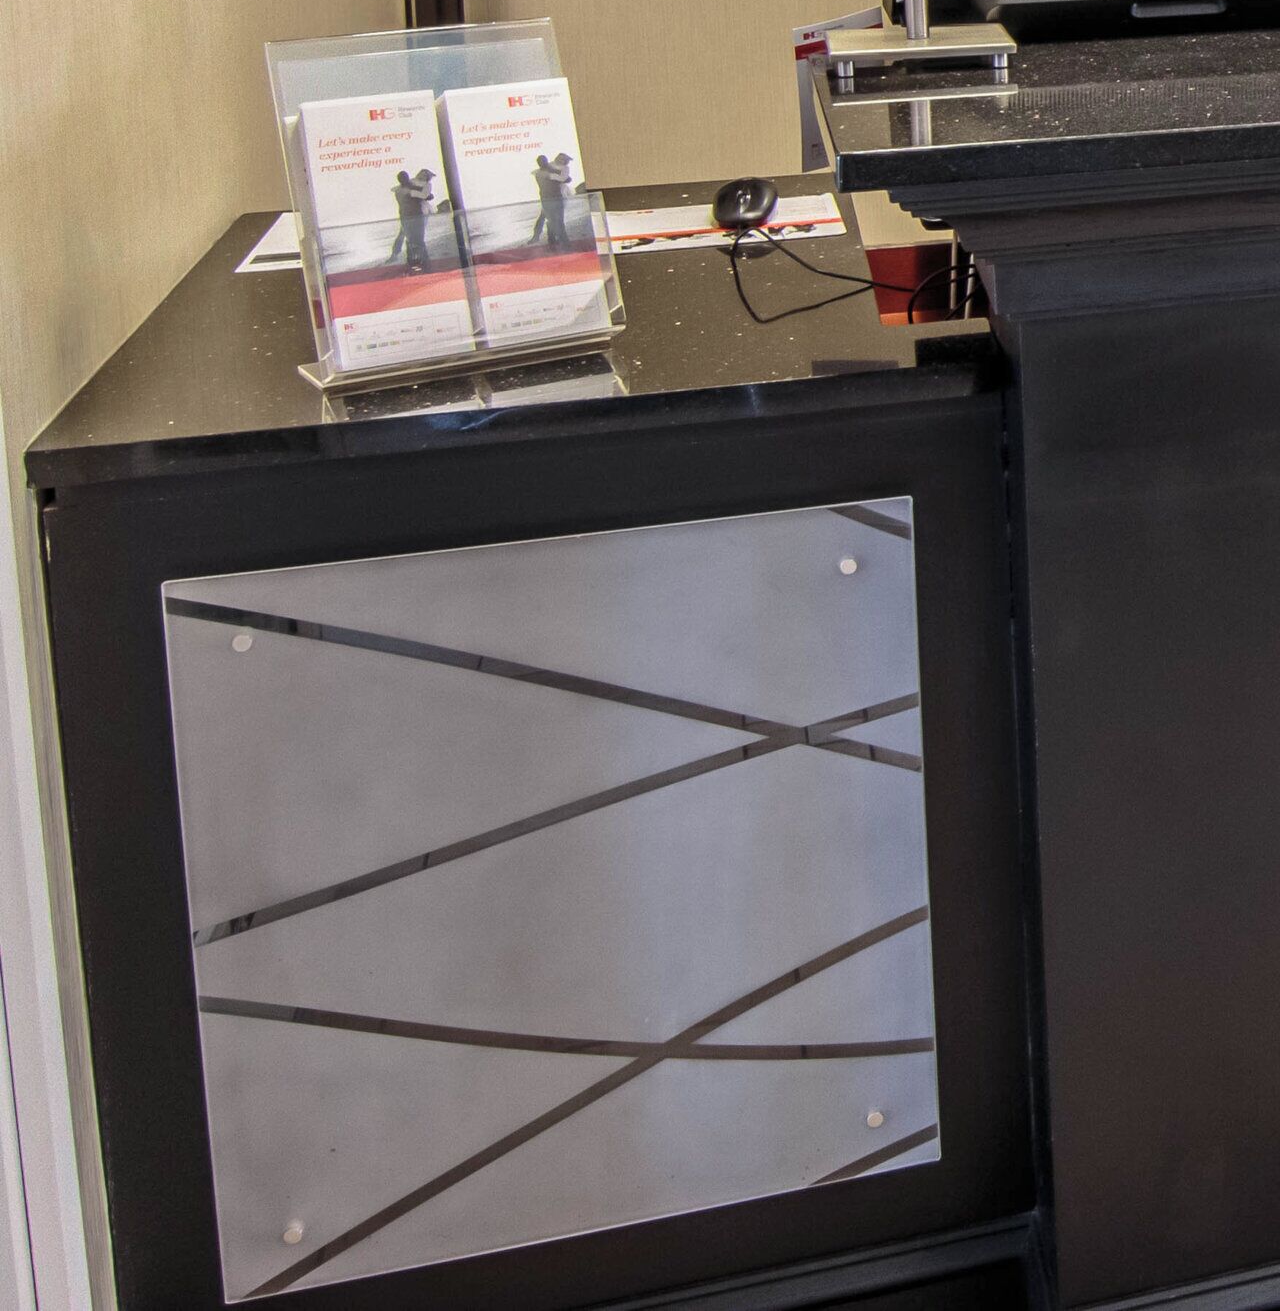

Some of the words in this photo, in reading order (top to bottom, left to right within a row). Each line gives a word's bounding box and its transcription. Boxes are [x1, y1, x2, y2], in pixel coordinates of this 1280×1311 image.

[507, 94, 532, 108] IHG
[369, 107, 395, 121] IHG
[460, 121, 487, 134] Let's
[489, 119, 519, 130] make
[318, 136, 346, 149] Let's
[349, 134, 380, 145] make
[382, 131, 414, 142] every
[462, 132, 522, 145] experience
[319, 147, 383, 161] experience
[384, 146, 392, 154] a
[463, 143, 523, 157] rewarding
[524, 141, 544, 150] one
[320, 158, 383, 173] rewarding
[384, 157, 406, 166] one
